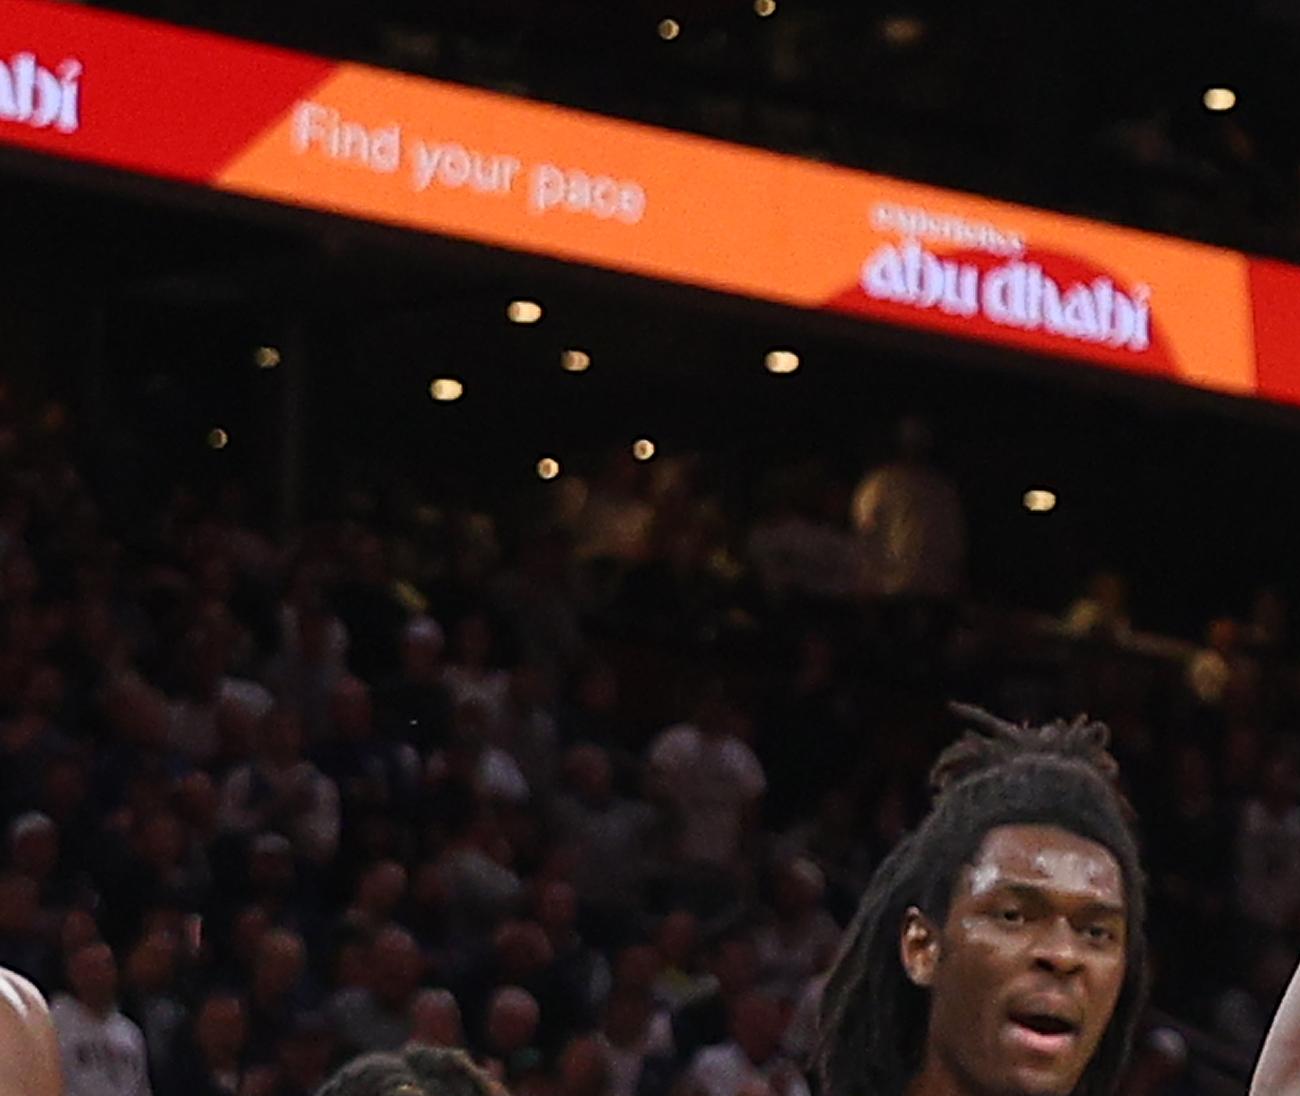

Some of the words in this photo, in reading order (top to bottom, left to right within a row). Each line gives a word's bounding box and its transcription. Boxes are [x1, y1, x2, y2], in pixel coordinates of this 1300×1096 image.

[292, 99, 402, 173] Find
[411, 139, 521, 193] your
[529, 163, 646, 226] pace
[861, 238, 981, 317] abu
[983, 258, 1153, 352] dhabi
